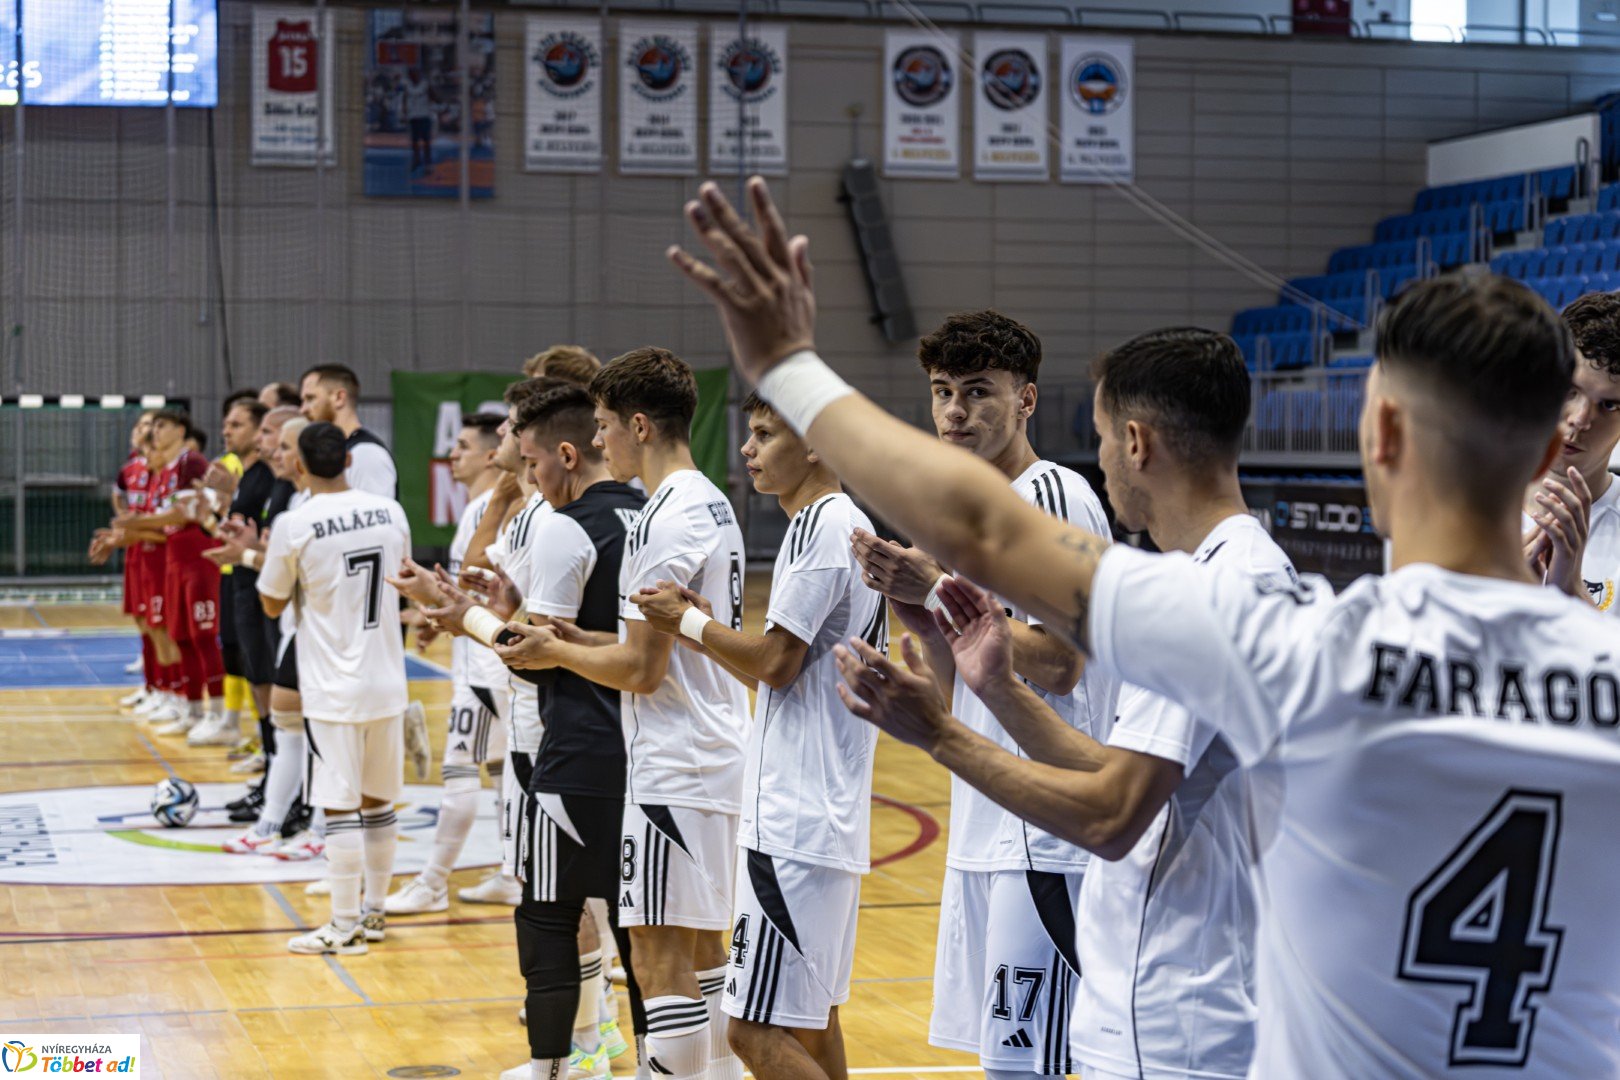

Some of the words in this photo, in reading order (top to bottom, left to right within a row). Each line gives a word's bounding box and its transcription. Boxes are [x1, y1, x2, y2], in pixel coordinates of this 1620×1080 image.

[279, 45, 308, 78] 15
[312, 508, 392, 539] BALÁZSI
[343, 545, 385, 630] 7
[1363, 641, 1620, 727] FARAGÓ
[727, 913, 750, 969] 4
[1396, 786, 1566, 1067] 4
[992, 964, 1046, 1021] 17
